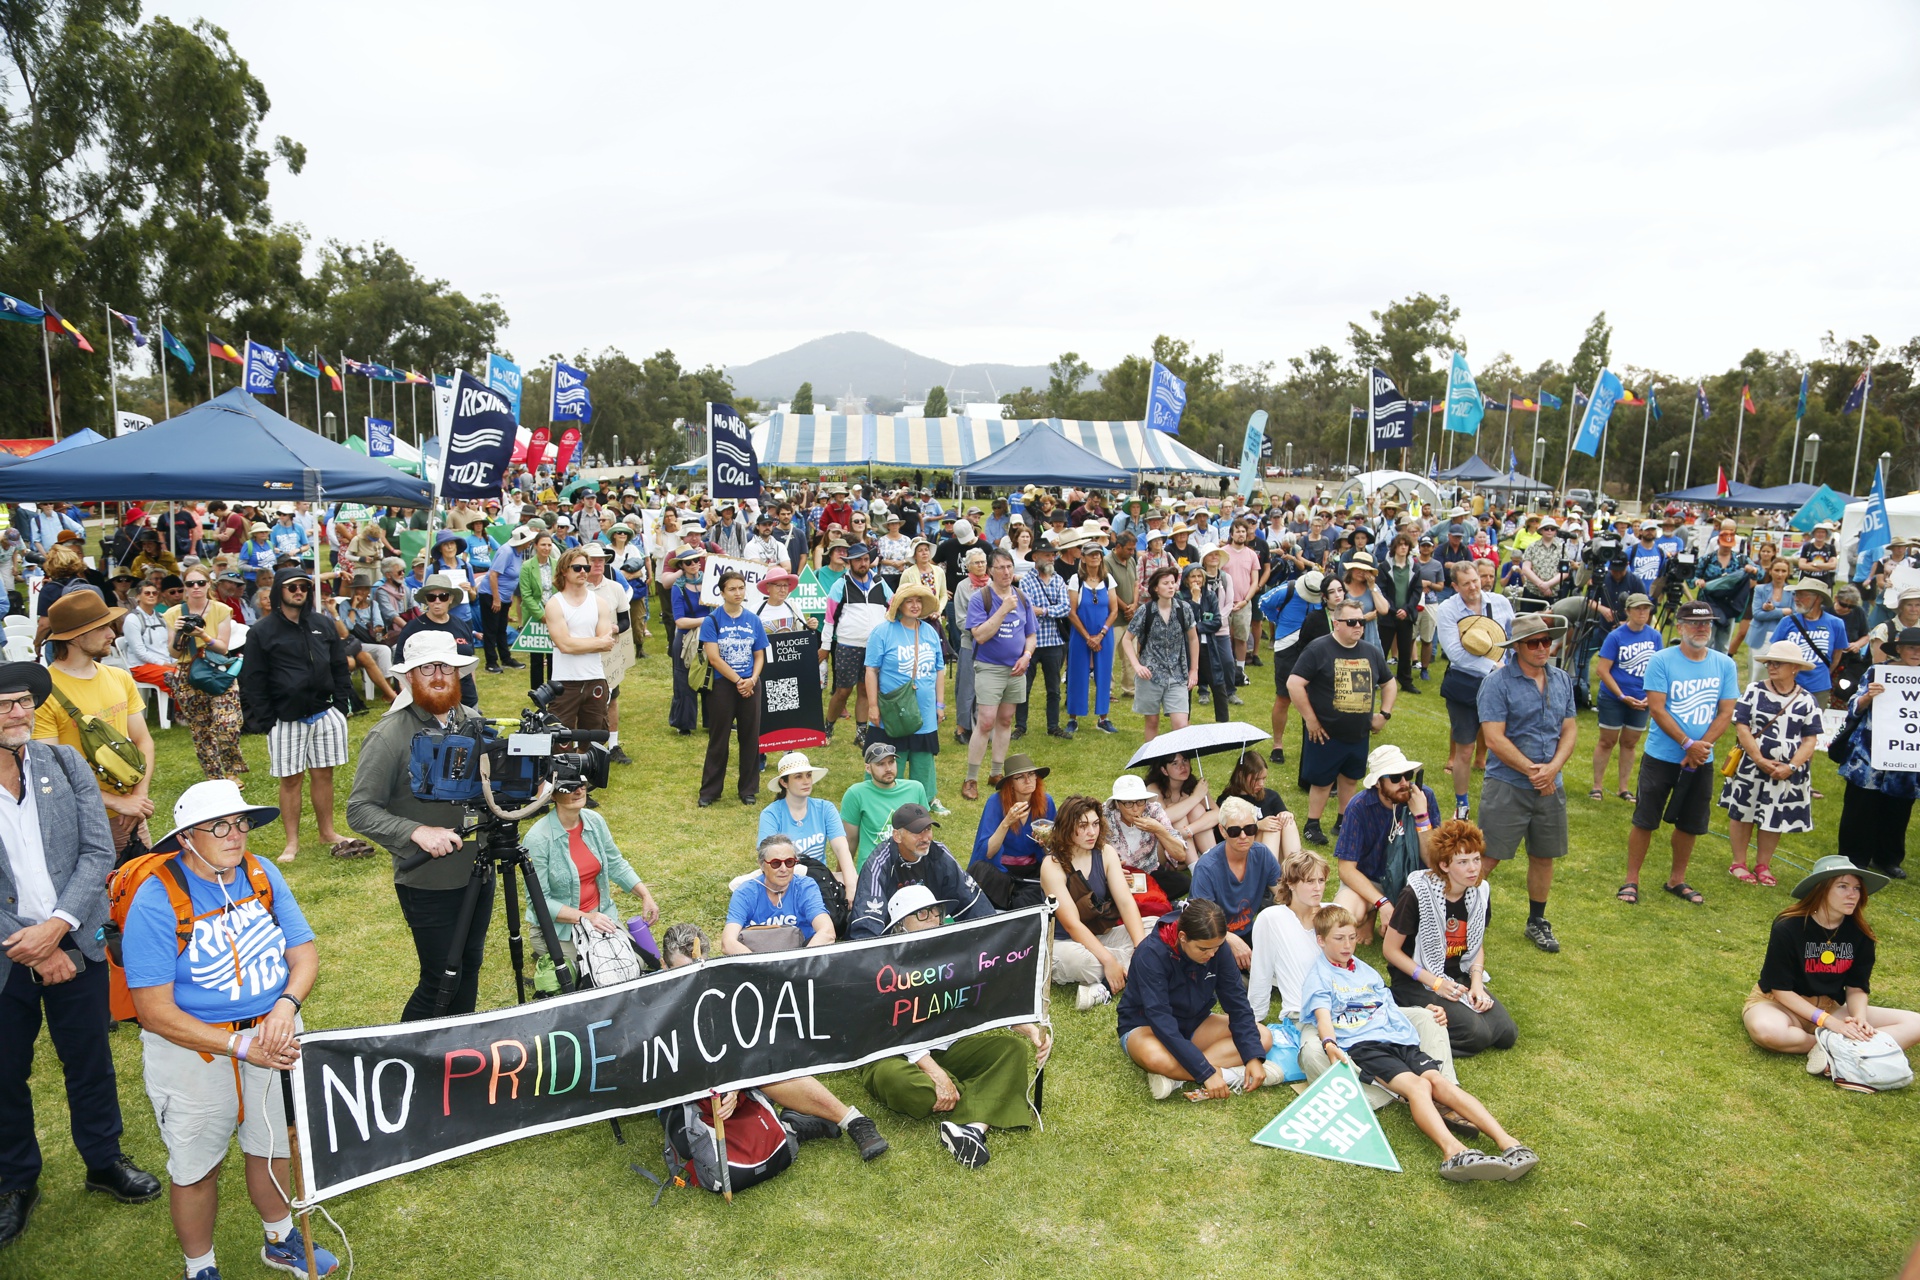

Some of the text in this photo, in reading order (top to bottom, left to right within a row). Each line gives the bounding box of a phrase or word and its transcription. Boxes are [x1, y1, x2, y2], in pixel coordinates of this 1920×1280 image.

[493, 367, 520, 391] No NEW
[1158, 370, 1171, 388] TAX
[1374, 376, 1396, 396] RIS
[559, 402, 585, 418] TIDE
[714, 413, 747, 440] No NEW
[1376, 421, 1405, 439] TIDE
[371, 440, 391, 453] COAL
[449, 461, 494, 488] TIDE
[717, 463, 754, 487] COAL
[340, 509, 367, 519] GREENS
[1634, 555, 1660, 567] RISING
[799, 583, 818, 596] THE
[530, 621, 550, 634] THE
[776, 638, 810, 648] MUDGEE
[1787, 630, 1830, 644] RIING
[777, 646, 799, 655] COAL
[777, 653, 803, 662] ALERT
[1618, 641, 1655, 661] RISING
[1626, 662, 1650, 677] TID
[1670, 677, 1720, 700] RISING
[1680, 703, 1717, 725] TIDE
[1904, 723, 1920, 734] O
[1883, 761, 1917, 769] Radical
[792, 832, 825, 851] SING
[876, 962, 955, 994] Queers
[1006, 945, 1034, 963] our
[892, 982, 987, 1027] PLANET
[322, 978, 831, 1154] NO PRIDE IN COAL
[1278, 1076, 1359, 1148] GREENS
[1320, 1112, 1373, 1155] THE
